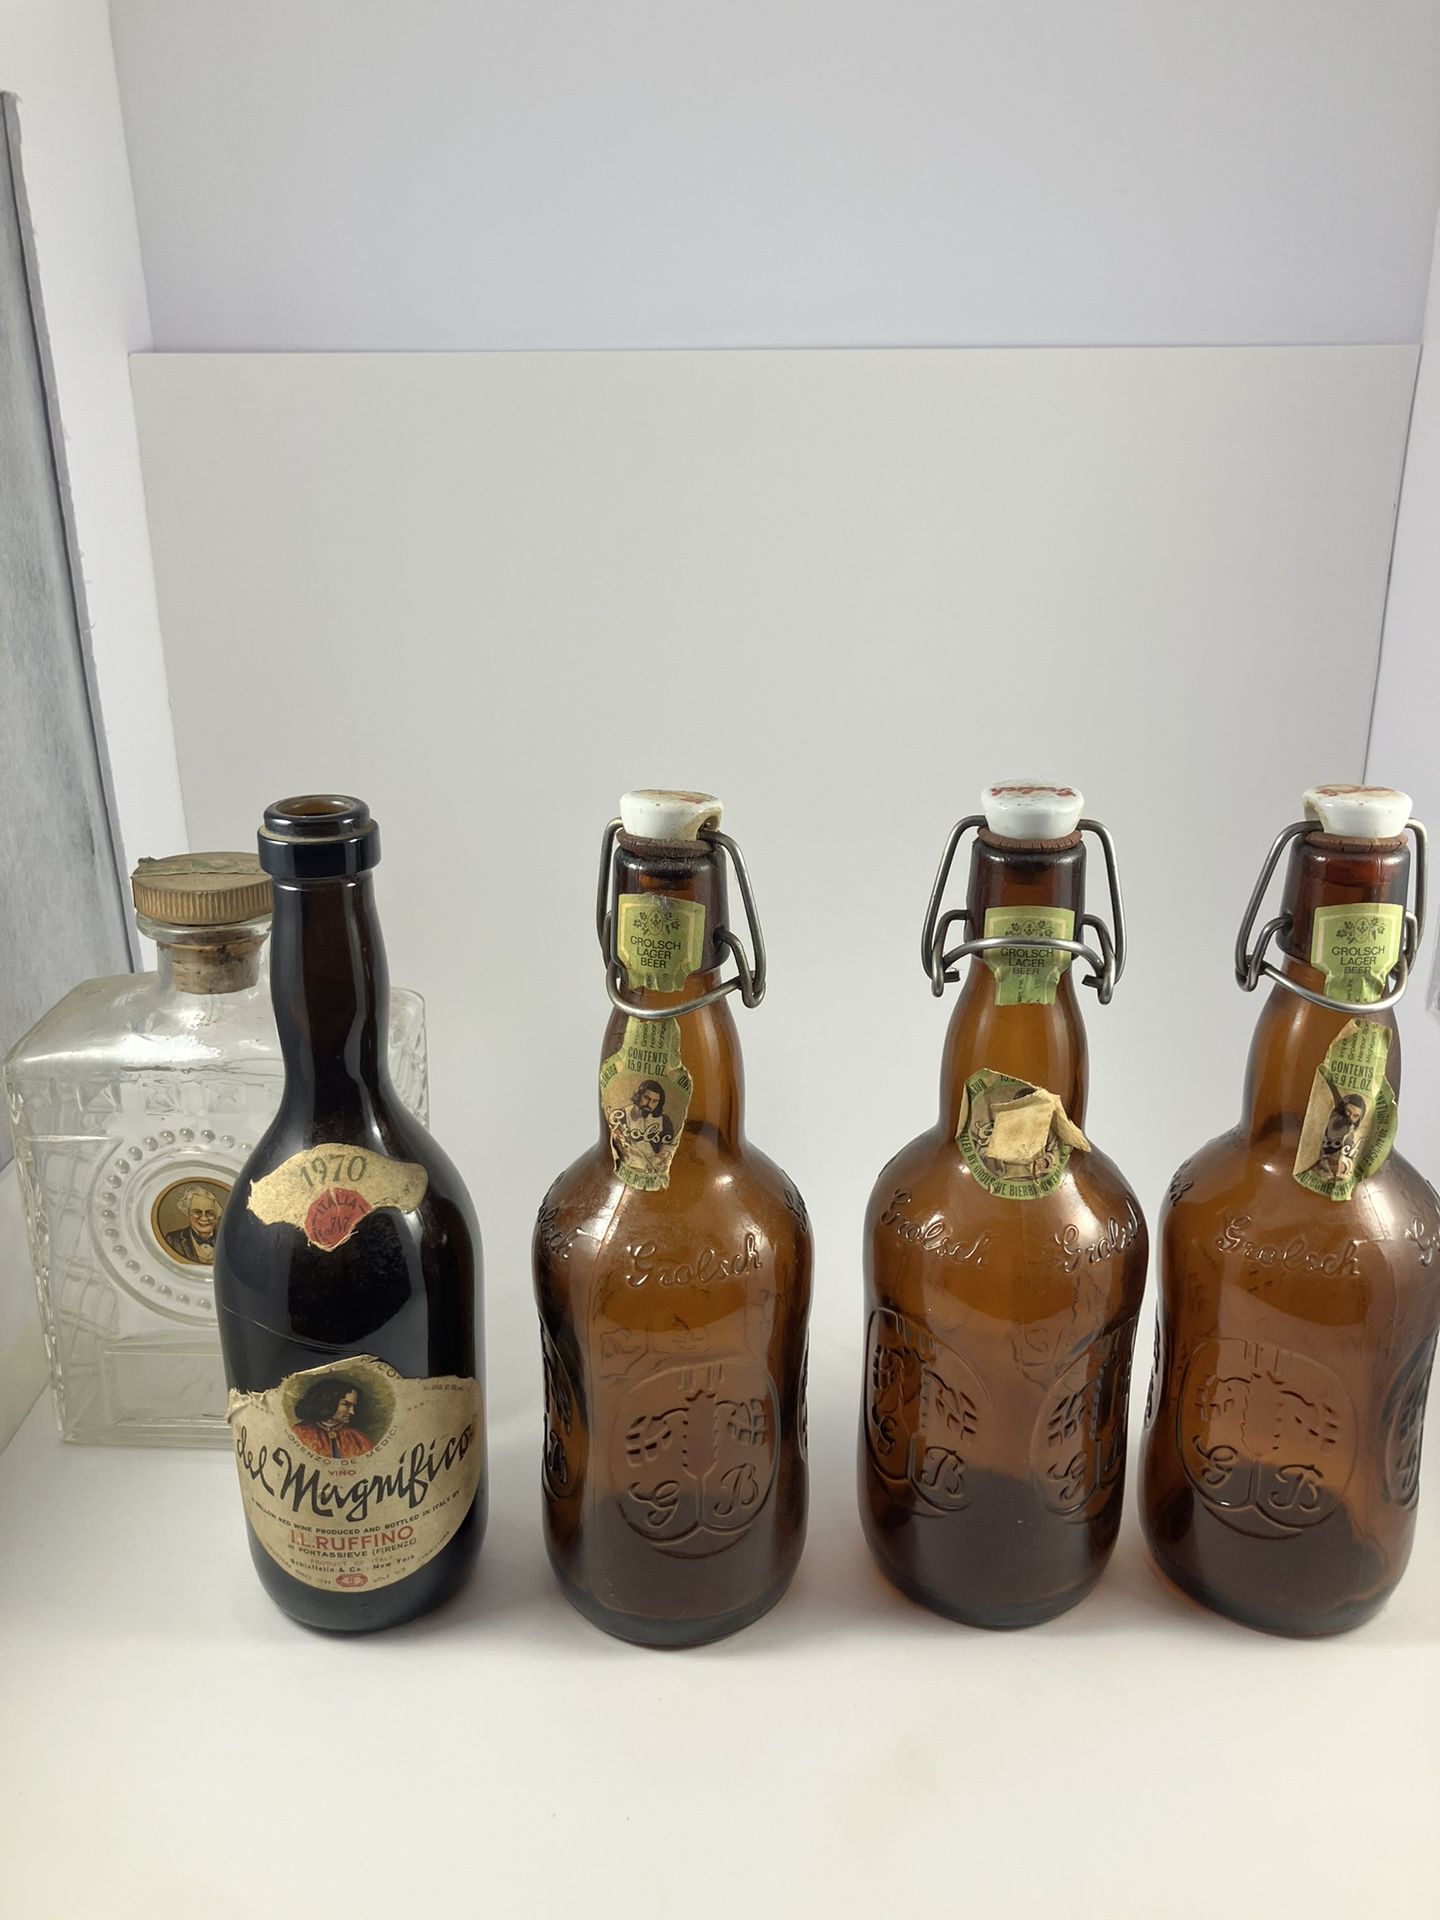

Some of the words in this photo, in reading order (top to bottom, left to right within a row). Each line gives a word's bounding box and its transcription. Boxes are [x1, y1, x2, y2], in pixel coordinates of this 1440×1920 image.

[630, 935, 682, 951] GROLSCH
[1331, 945, 1386, 957] GROLSCH
[637, 947, 672, 960] LAGER
[1000, 947, 1054, 958] GROLSCH
[640, 957, 667, 969] BEER
[1008, 959, 1045, 968] LAGER
[1340, 956, 1377, 966] LAGER
[1012, 967, 1040, 975] BEER
[1343, 965, 1372, 974] BEER
[627, 1046, 669, 1065] CONTENTS
[627, 1060, 642, 1073] 15.9
[1330, 1060, 1374, 1080] CONTENTS
[300, 1154, 367, 1189] 1970
[315, 1193, 358, 1215] ITALIA
[1217, 1214, 1361, 1279] Grolsch
[626, 1232, 763, 1289] Grolsch
[365, 1424, 399, 1460] MEDICI
[236, 1425, 276, 1497] del
[272, 1423, 474, 1523] Magnifico
[327, 1469, 357, 1477] VINO
[279, 1517, 291, 1527] RED
[294, 1523, 313, 1533] WINE
[316, 1527, 361, 1536] PRODUCED
[363, 1526, 381, 1534] AND
[384, 1514, 420, 1531] BOTTLED
[422, 1509, 431, 1517] IN
[432, 1496, 451, 1512] ITALY
[373, 1562, 392, 1570] New
[396, 1554, 415, 1564] York
